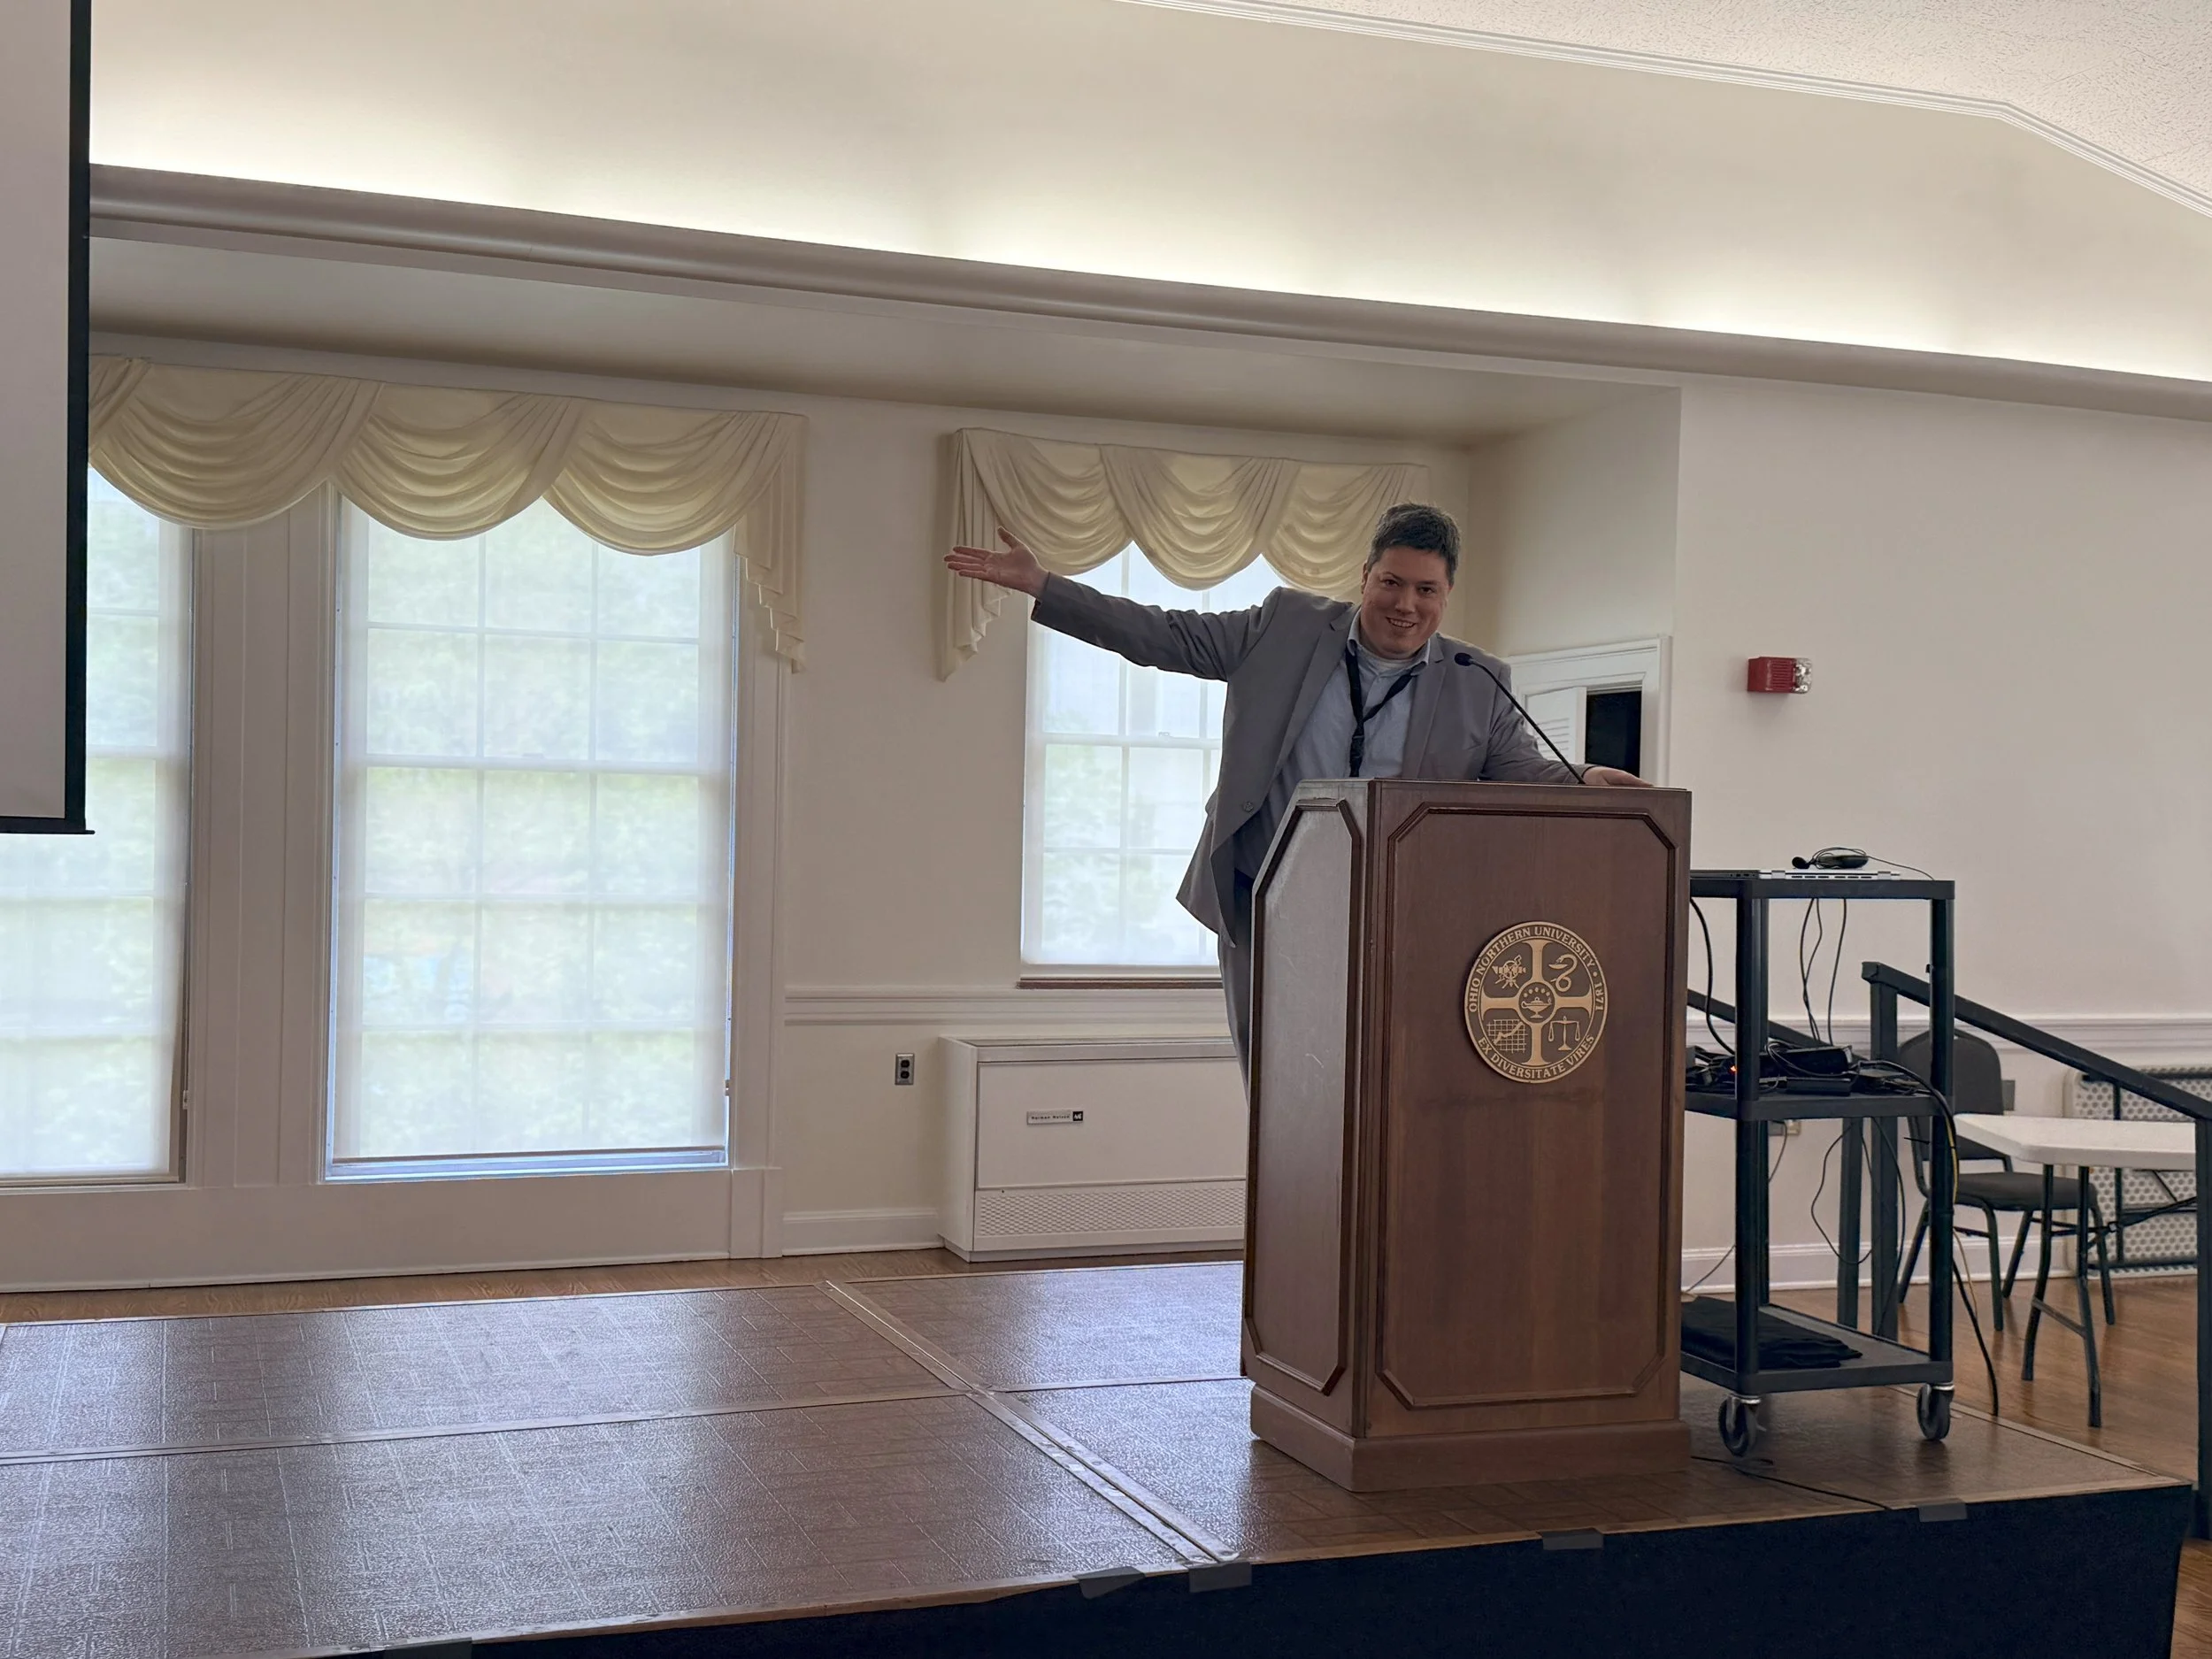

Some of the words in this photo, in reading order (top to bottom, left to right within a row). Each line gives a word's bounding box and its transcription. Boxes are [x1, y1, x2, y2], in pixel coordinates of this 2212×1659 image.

[1469, 977, 1480, 1013] OHIO
[1479, 927, 1531, 977] NORTHERN
[1534, 926, 1595, 969] UNIVERSITY
[1594, 982, 1604, 1011] 1871
[1478, 1037, 1492, 1053] EX
[1490, 1051, 1566, 1079] DIVERSITATE
[1567, 1034, 1594, 1067] VIRES
